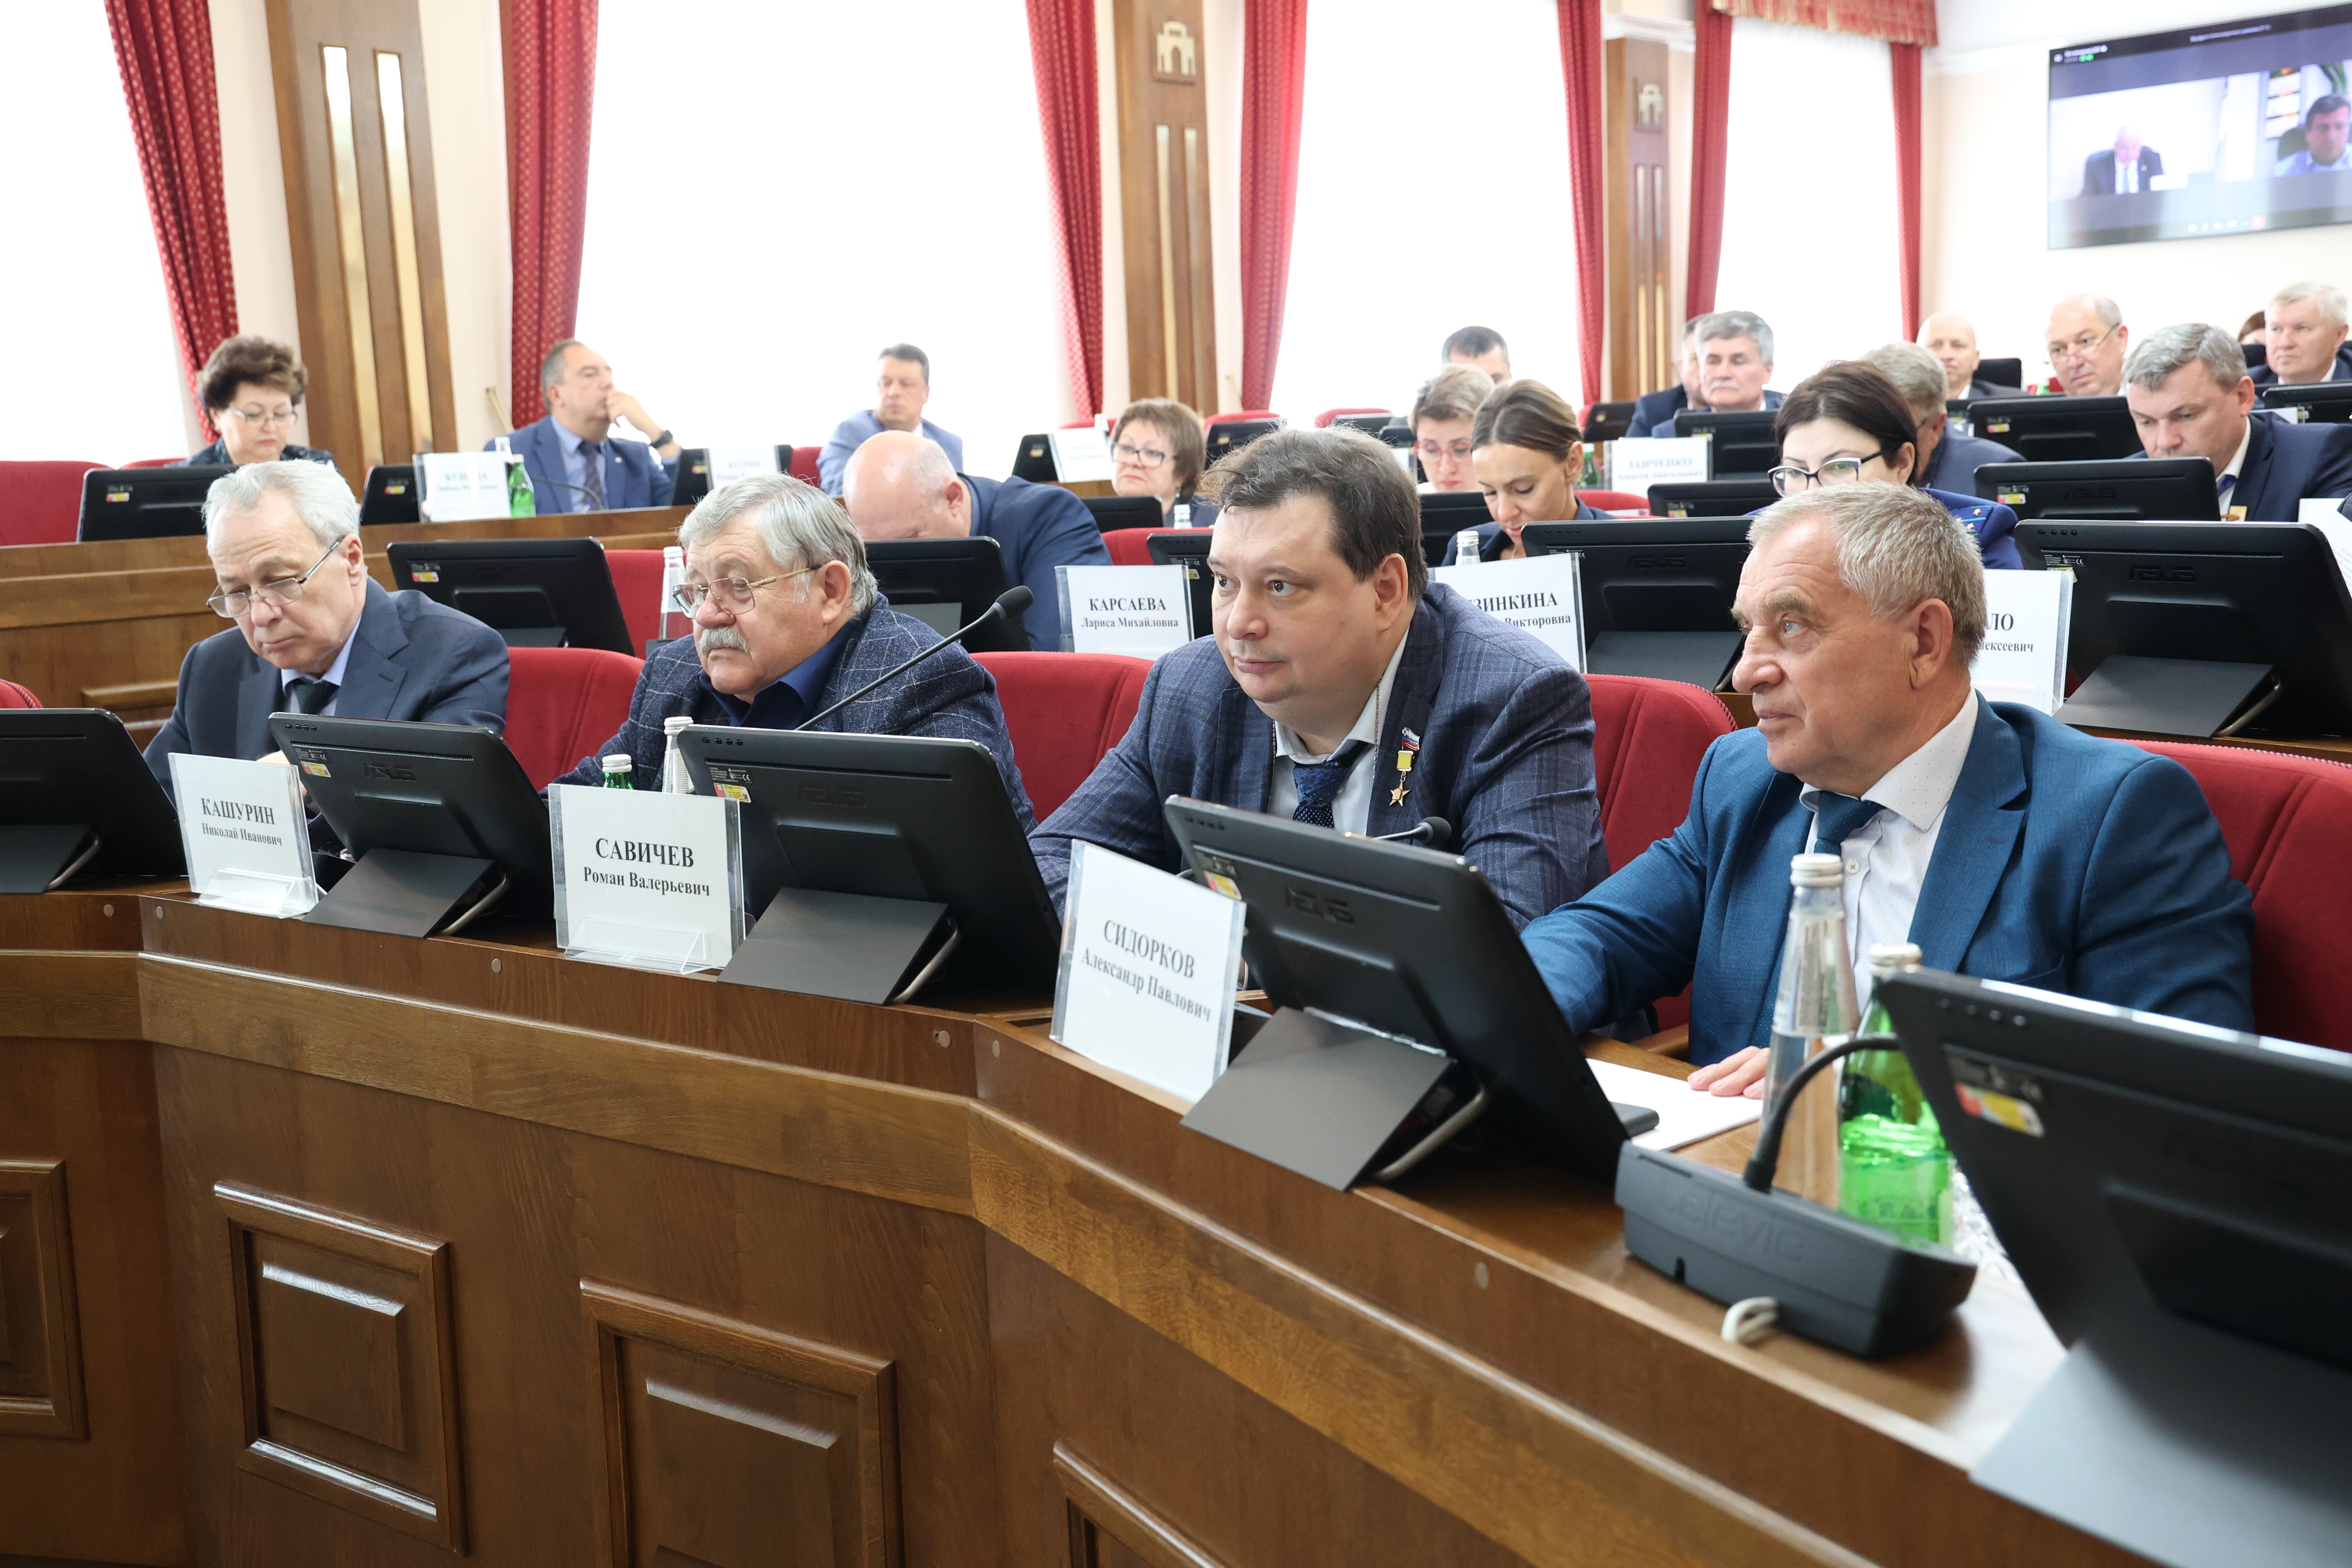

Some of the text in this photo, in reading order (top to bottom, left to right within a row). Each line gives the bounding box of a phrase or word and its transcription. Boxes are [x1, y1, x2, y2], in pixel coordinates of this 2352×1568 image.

[1626, 555, 1687, 569] ASUS
[2128, 565, 2196, 583] ASUS
[1089, 597, 1167, 611] КАРСАЕВА
[1469, 592, 1558, 612] ЗИНКИНА
[1081, 617, 1179, 629] Лариса Михайловна
[1504, 615, 1571, 628] Викторовна
[364, 762, 416, 781] ASUS
[797, 783, 867, 808] ASUS
[201, 798, 276, 825] КАШУРИН
[202, 823, 282, 846] Николай Иванович
[596, 838, 694, 867] САВИЧЕВ
[583, 867, 710, 896] Роман Валерьевич
[1104, 920, 1195, 979] СИДОРКОВ
[1081, 946, 1211, 1022] Александр Павлович
